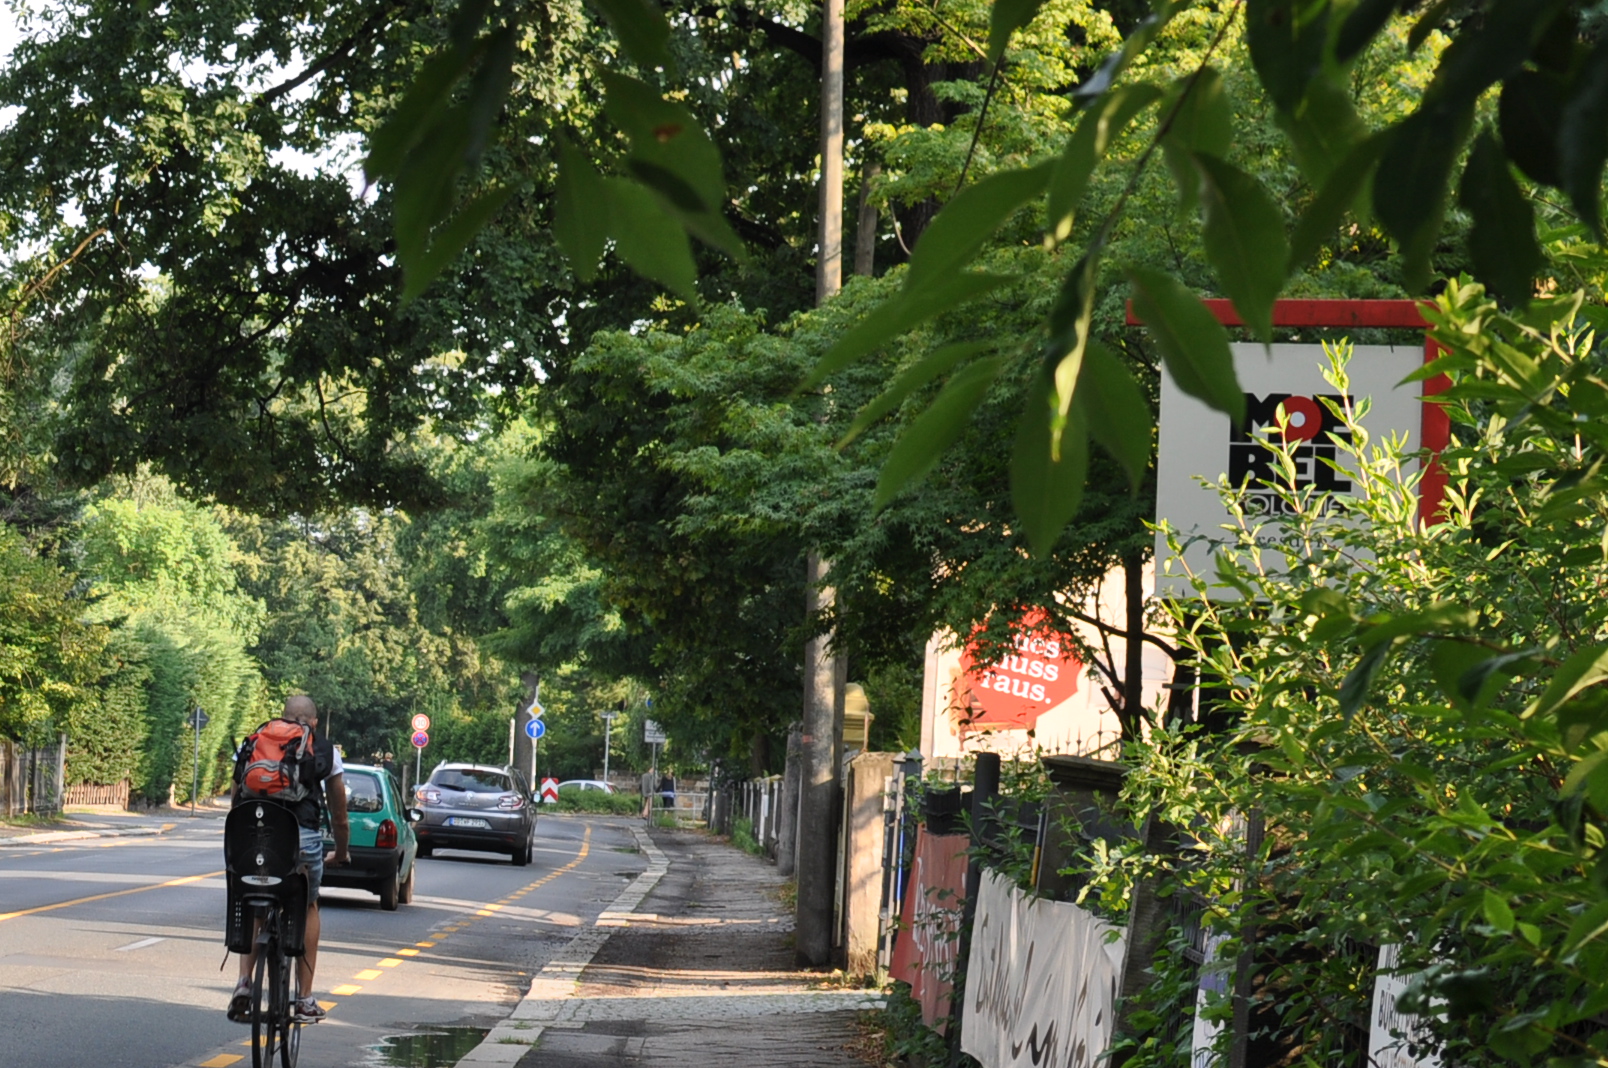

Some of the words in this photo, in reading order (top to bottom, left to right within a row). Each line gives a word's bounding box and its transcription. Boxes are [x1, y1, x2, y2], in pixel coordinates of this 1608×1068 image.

[1230, 393, 1355, 445] MOE
[1228, 444, 1352, 493] BEL
[1232, 494, 1342, 518] OLONIE
[980, 671, 1051, 704] raus.
